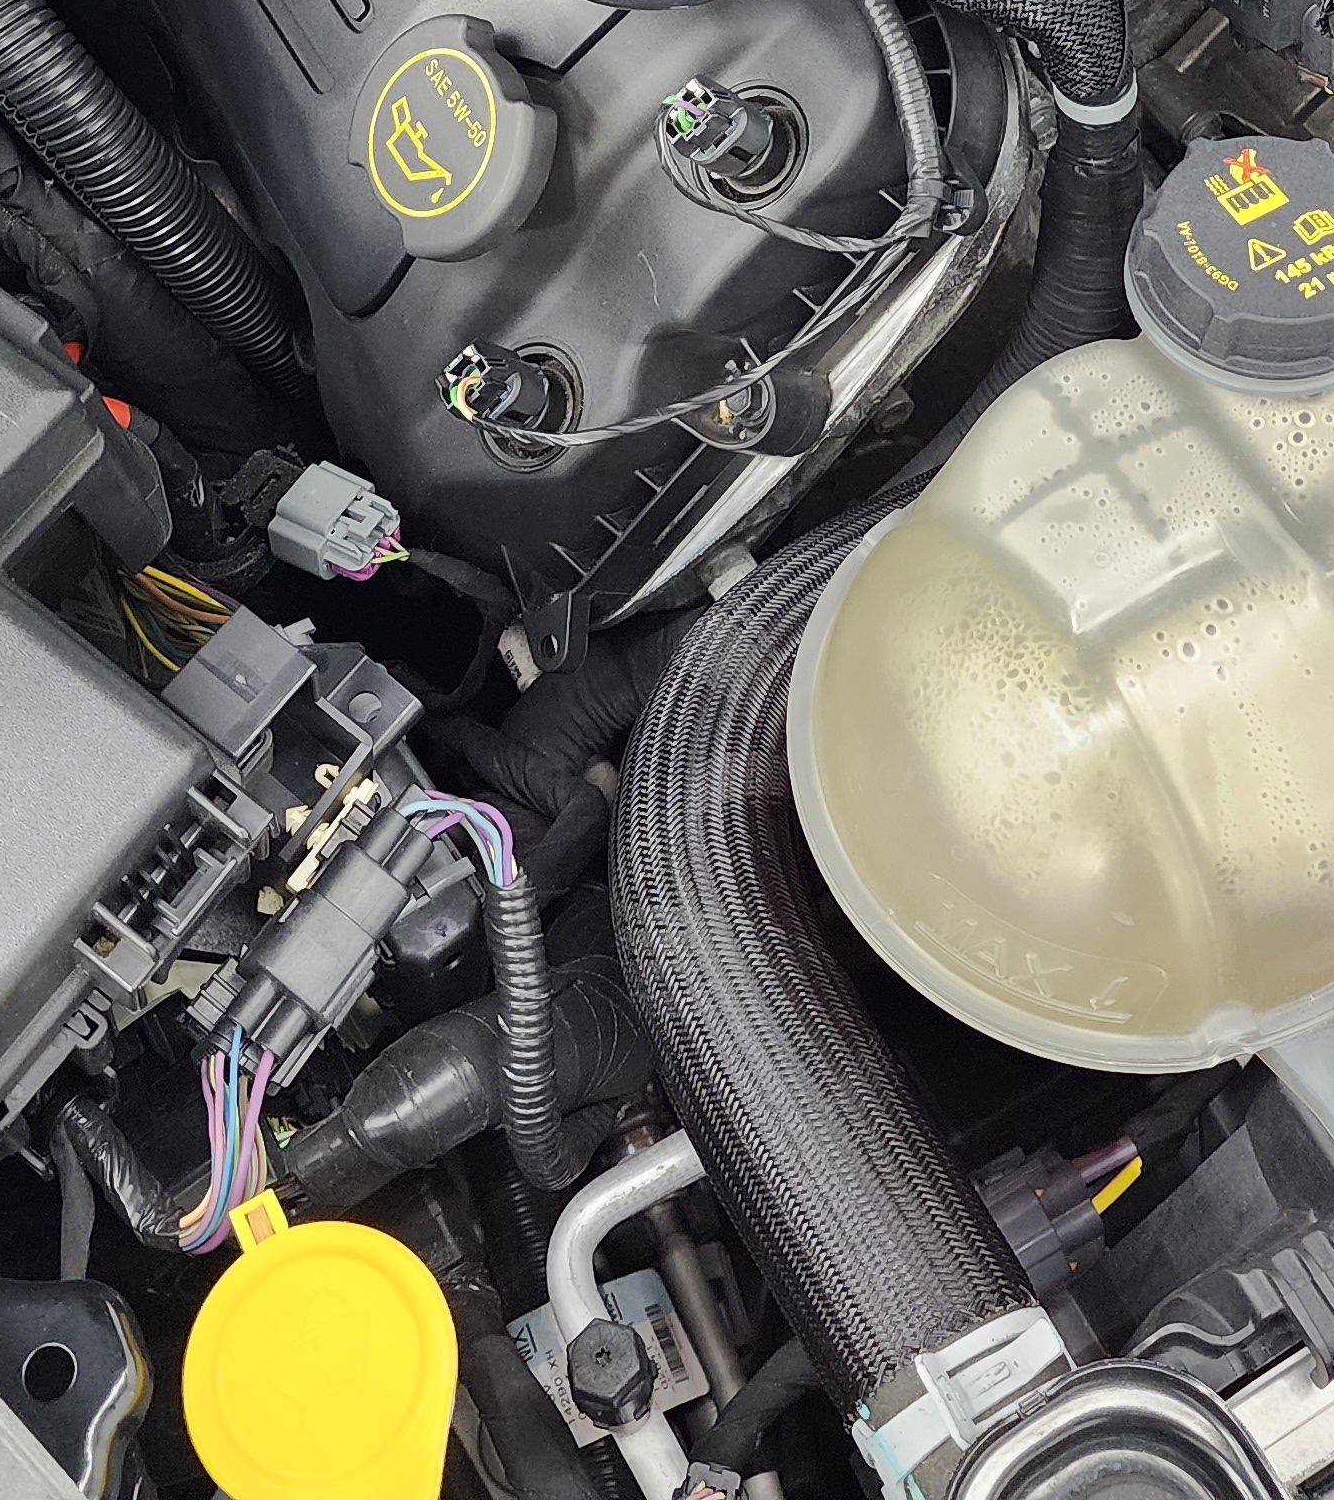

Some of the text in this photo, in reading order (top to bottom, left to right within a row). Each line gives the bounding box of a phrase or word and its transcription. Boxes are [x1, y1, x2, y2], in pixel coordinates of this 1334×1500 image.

[422, 58, 491, 149] SAE 5W-50
[1273, 256, 1313, 286] 145
[1297, 276, 1325, 299] 21
[926, 898, 1074, 1002] MAX
